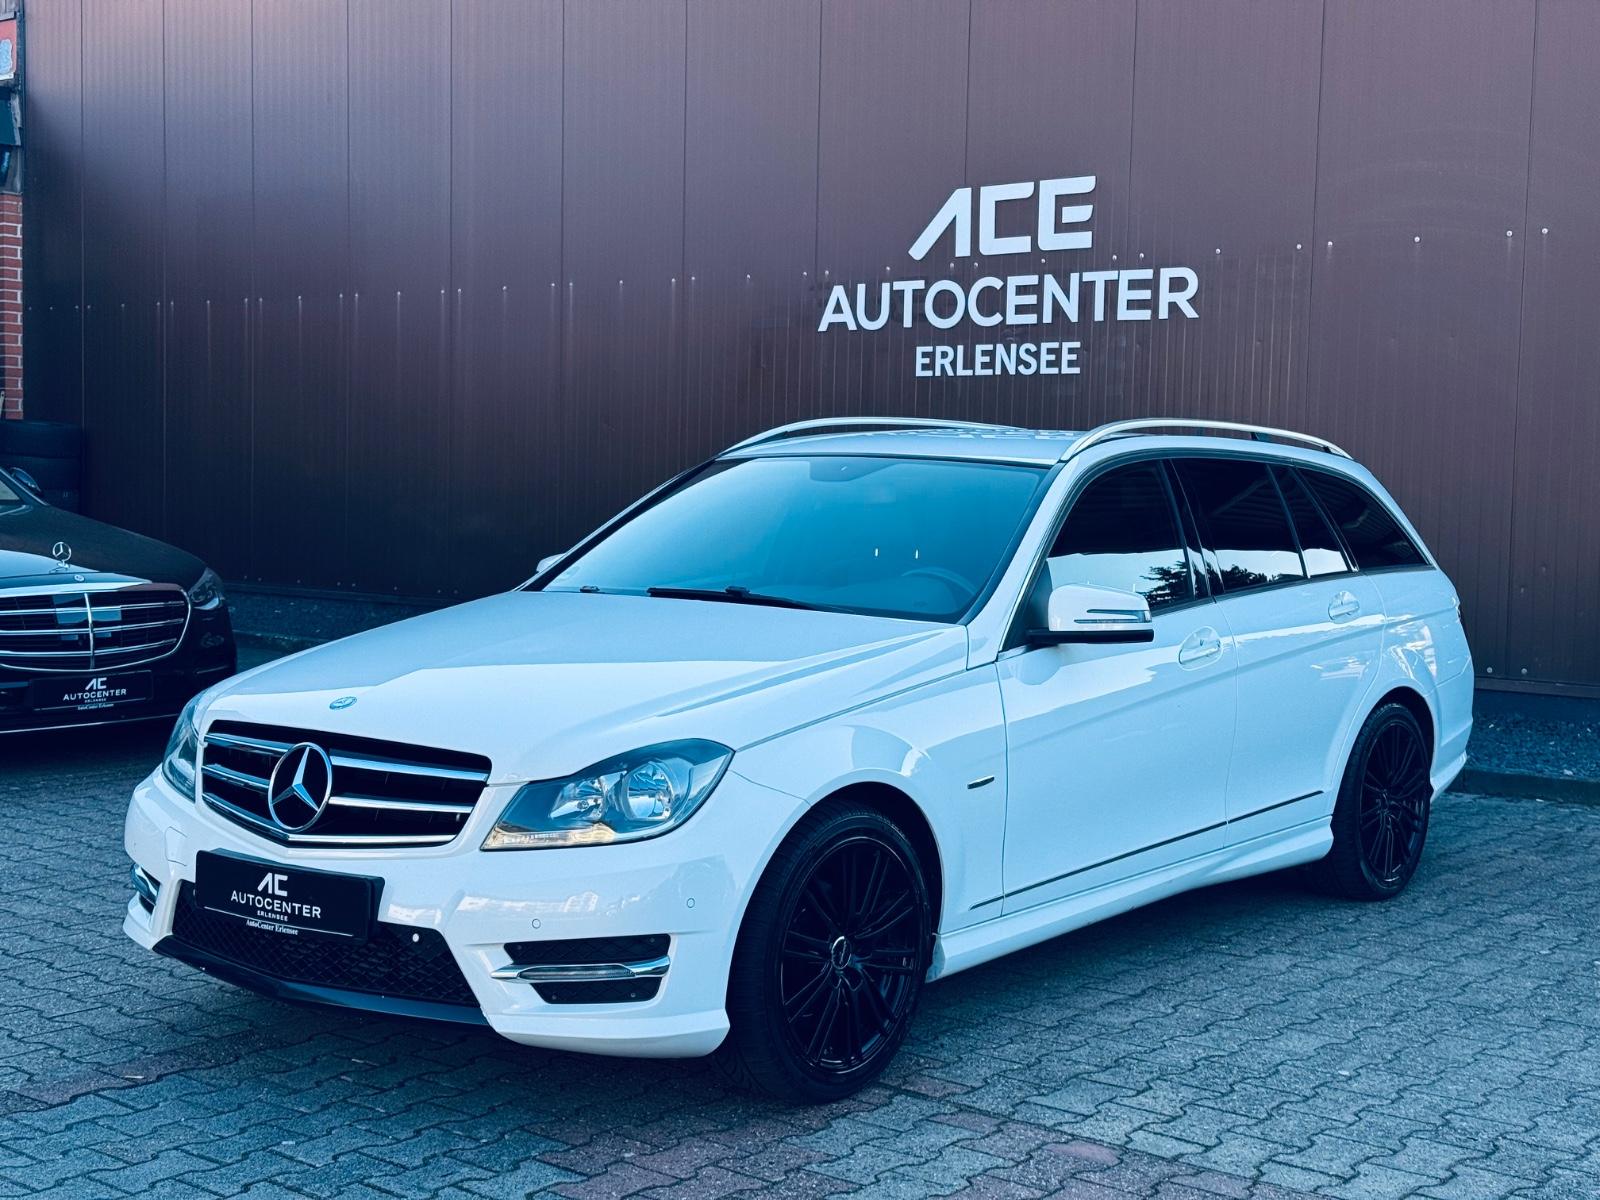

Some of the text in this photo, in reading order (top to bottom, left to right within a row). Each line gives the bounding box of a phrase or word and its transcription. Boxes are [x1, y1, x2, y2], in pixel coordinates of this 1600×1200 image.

[908, 175, 1096, 261] ACE
[817, 266, 1200, 333] AUTOCENTER
[915, 341, 1081, 377] ERLENSEE
[63, 688, 127, 701] AUTOCENTER
[257, 872, 288, 897] AC
[231, 890, 321, 919] AUTOCENTER
[257, 910, 288, 922] ERLENSEE
